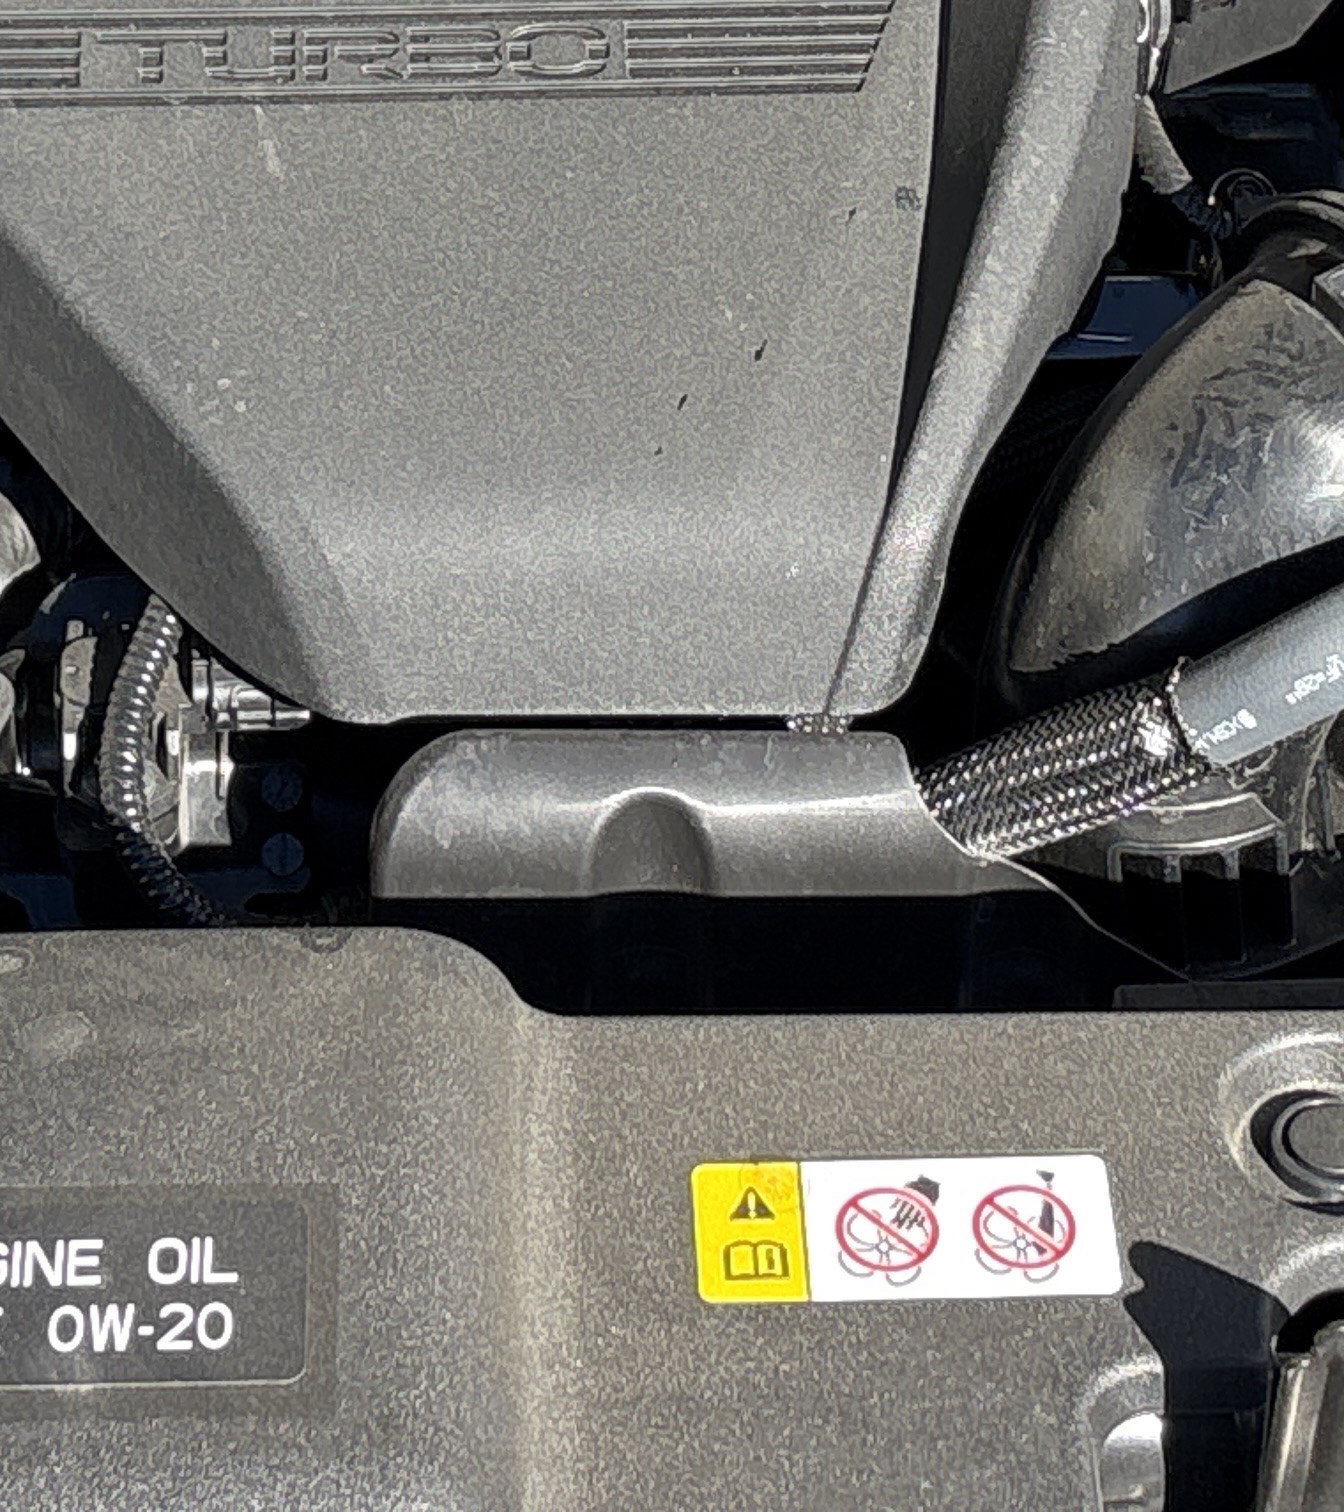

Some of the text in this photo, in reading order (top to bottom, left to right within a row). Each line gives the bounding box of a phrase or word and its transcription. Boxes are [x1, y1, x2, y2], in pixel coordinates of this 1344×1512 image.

[92, 24, 616, 85] TURBO
[146, 1235, 239, 1285] OIL
[47, 1301, 234, 1352] 0W-20
